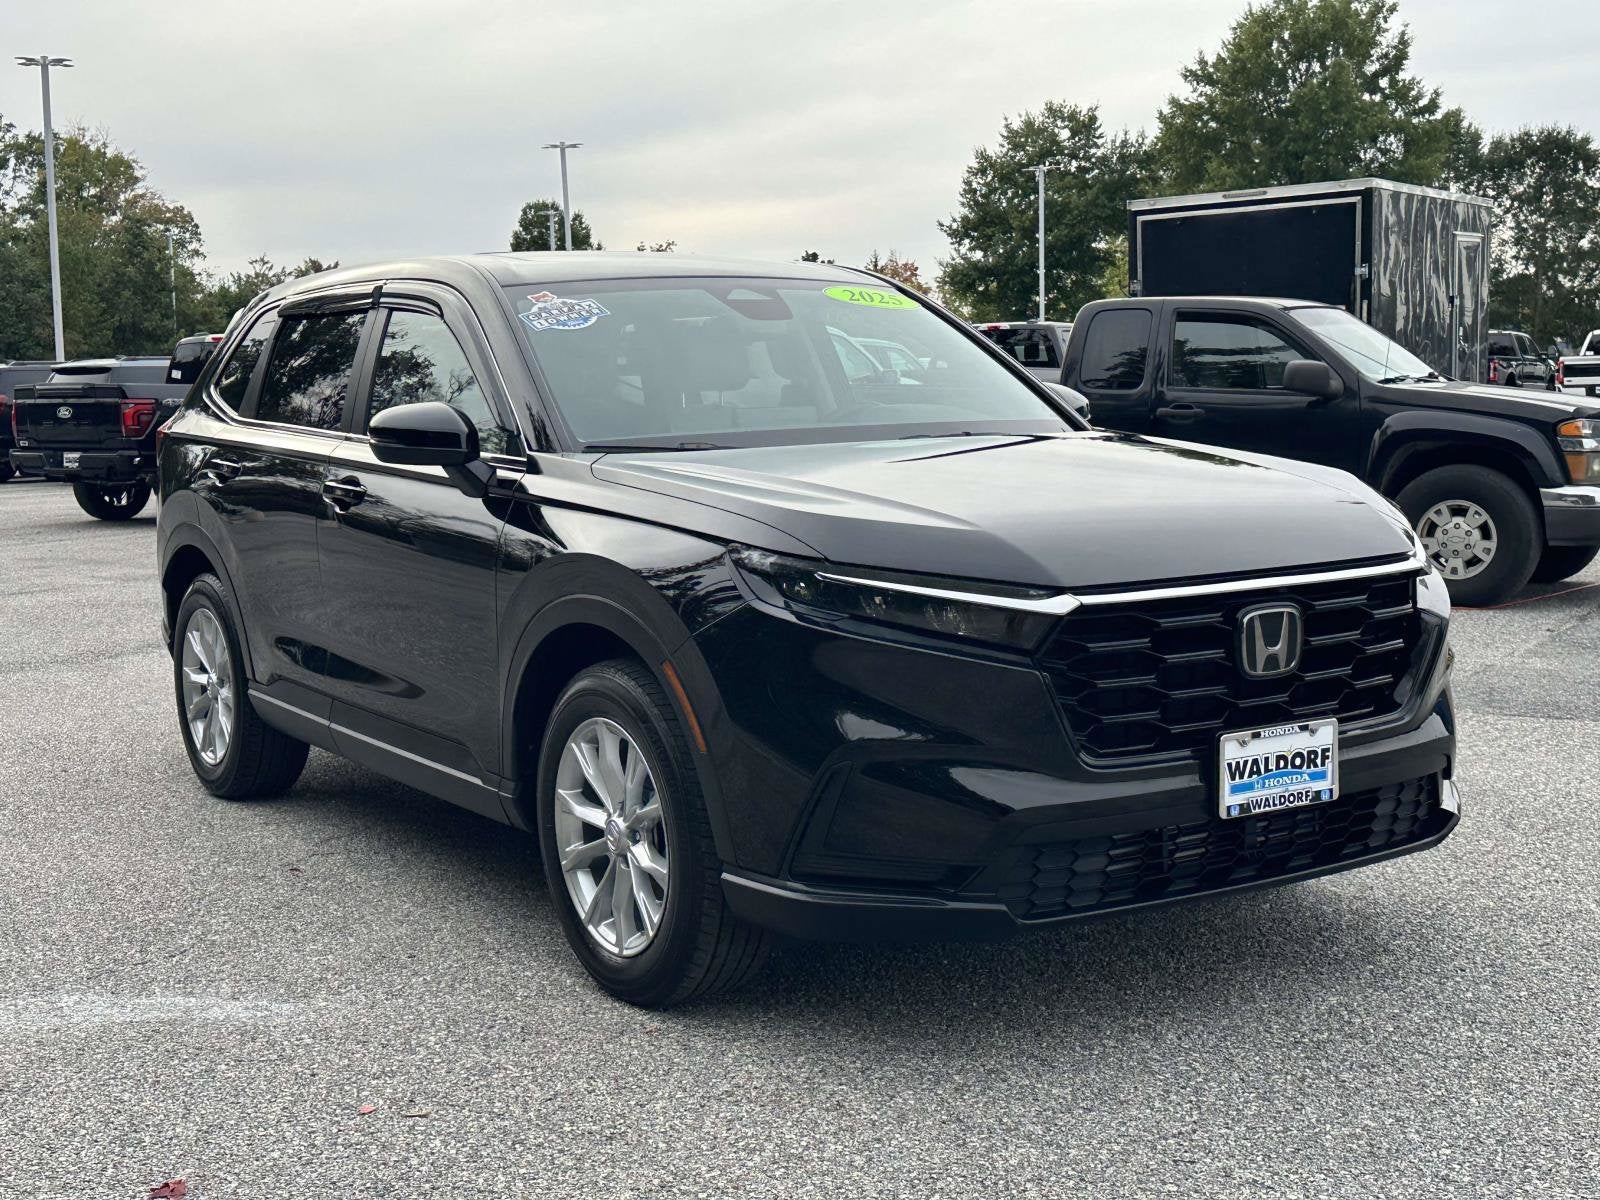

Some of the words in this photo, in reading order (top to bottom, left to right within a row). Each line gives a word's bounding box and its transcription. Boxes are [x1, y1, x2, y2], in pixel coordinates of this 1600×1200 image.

[1260, 726, 1301, 738] HONDA
[1226, 746, 1331, 782] WALDORF
[1264, 773, 1311, 788] HONDA
[1250, 789, 1312, 812] WALDORF
